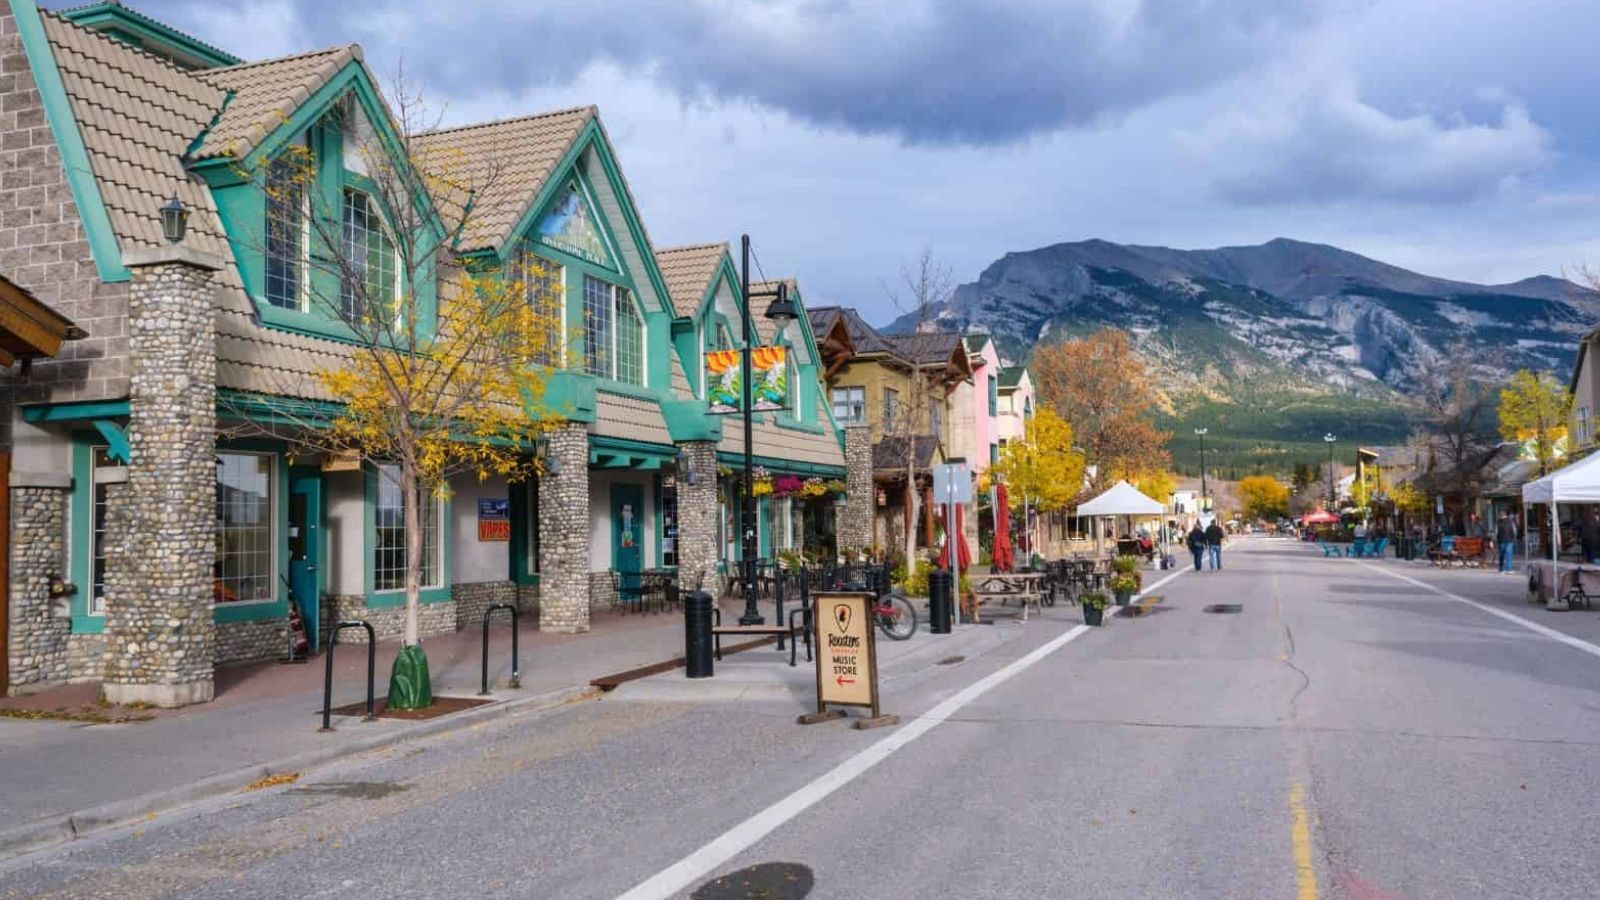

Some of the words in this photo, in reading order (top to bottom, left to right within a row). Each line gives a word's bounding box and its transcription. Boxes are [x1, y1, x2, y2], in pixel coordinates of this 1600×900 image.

[480, 520, 509, 538] VAPES
[832, 656, 856, 665] MUSIC
[833, 666, 857, 675] STORE
